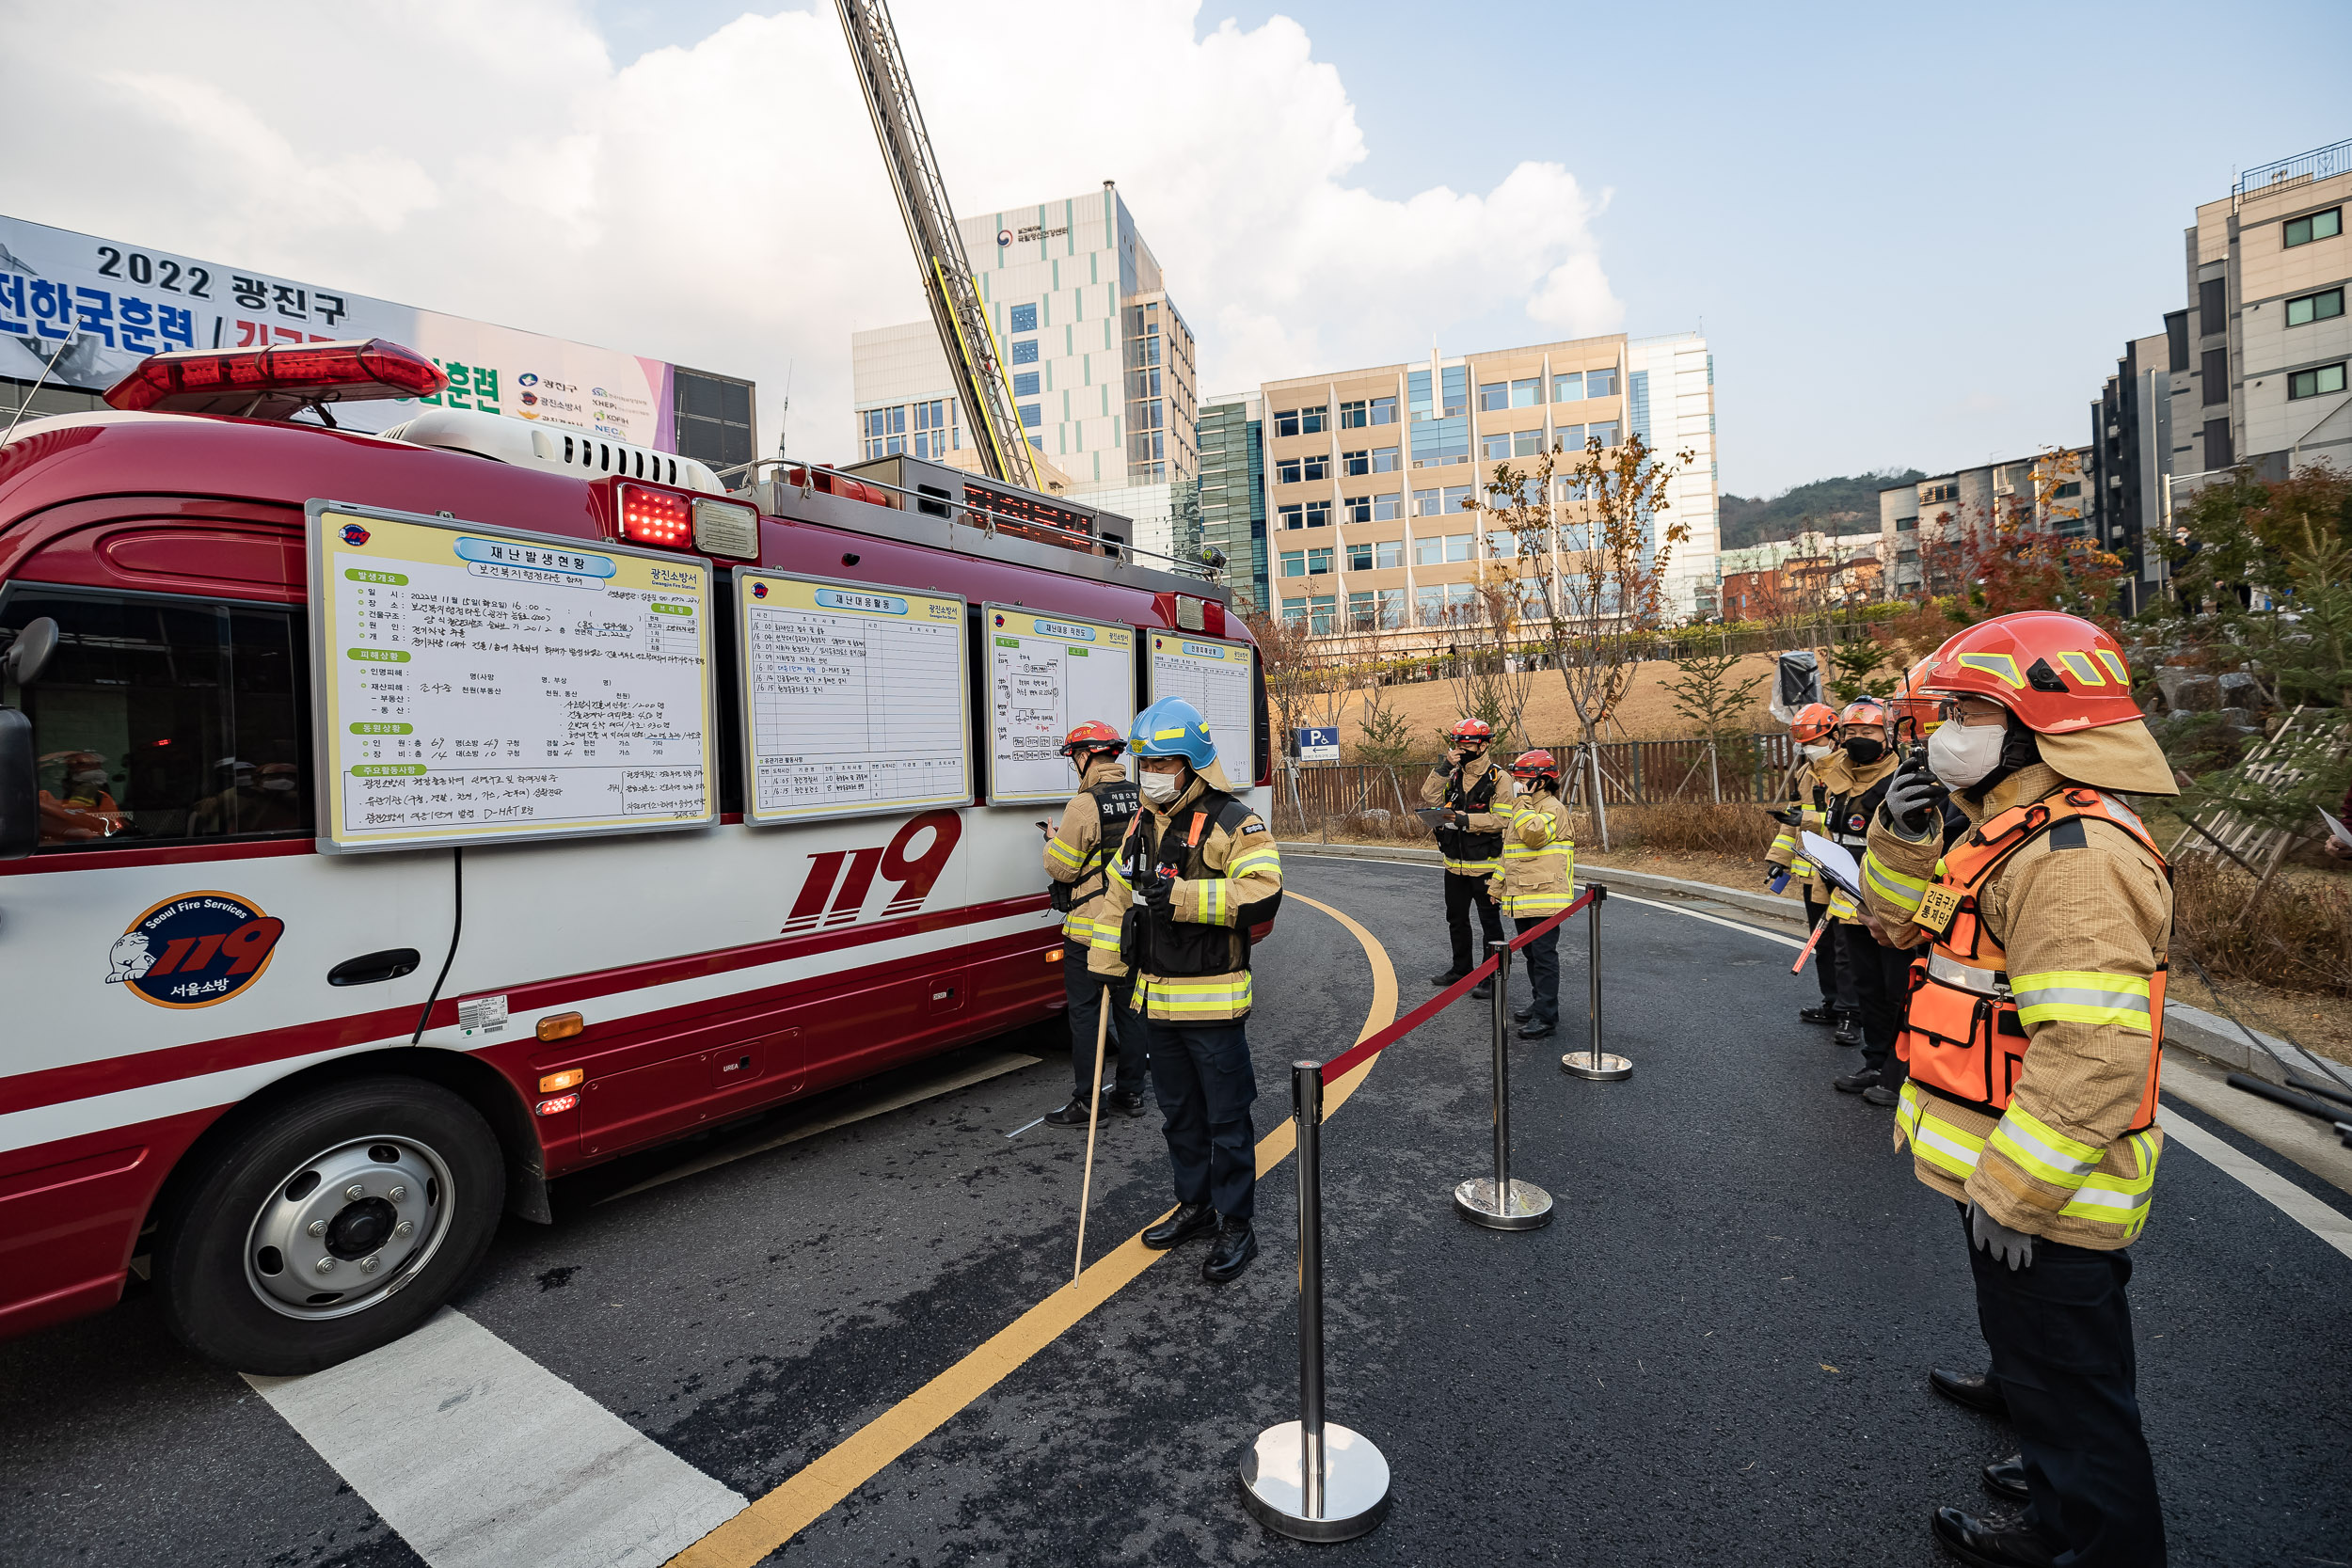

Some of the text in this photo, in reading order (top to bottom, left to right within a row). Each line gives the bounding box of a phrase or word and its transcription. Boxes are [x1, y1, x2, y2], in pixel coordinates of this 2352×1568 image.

[98, 245, 344, 325] 2022 광진구
[542, 379, 577, 393] 광진구
[540, 397, 581, 413] 광진소방서
[595, 424, 627, 437] NECA
[491, 546, 584, 570] 재난발생현황
[358, 571, 396, 583] 발생개요
[650, 568, 697, 584] 광진소방서
[835, 594, 890, 610] 재난대응활동
[369, 611, 400, 620] 건물구조
[660, 605, 683, 613] 브리핑
[929, 605, 958, 615] 광진소방서
[1046, 624, 1068, 635] 재난대응
[360, 650, 399, 661] 피해상황
[371, 668, 403, 676] 인명피해
[553, 676, 567, 685] 부상
[371, 683, 404, 691] 재산피해
[363, 723, 401, 733] 동원상황
[431, 737, 445, 749] 69
[484, 738, 499, 749] 49
[1310, 730, 1322, 745] P
[363, 767, 416, 775] 주요활동사항
[1103, 801, 1143, 816] 화재조
[780, 809, 962, 934] 119
[1159, 867, 1179, 879] 119
[145, 899, 247, 929] Seoul Fire Services
[147, 917, 282, 977] 119
[170, 978, 230, 997] 서울소방
[723, 1063, 739, 1072] UREA
